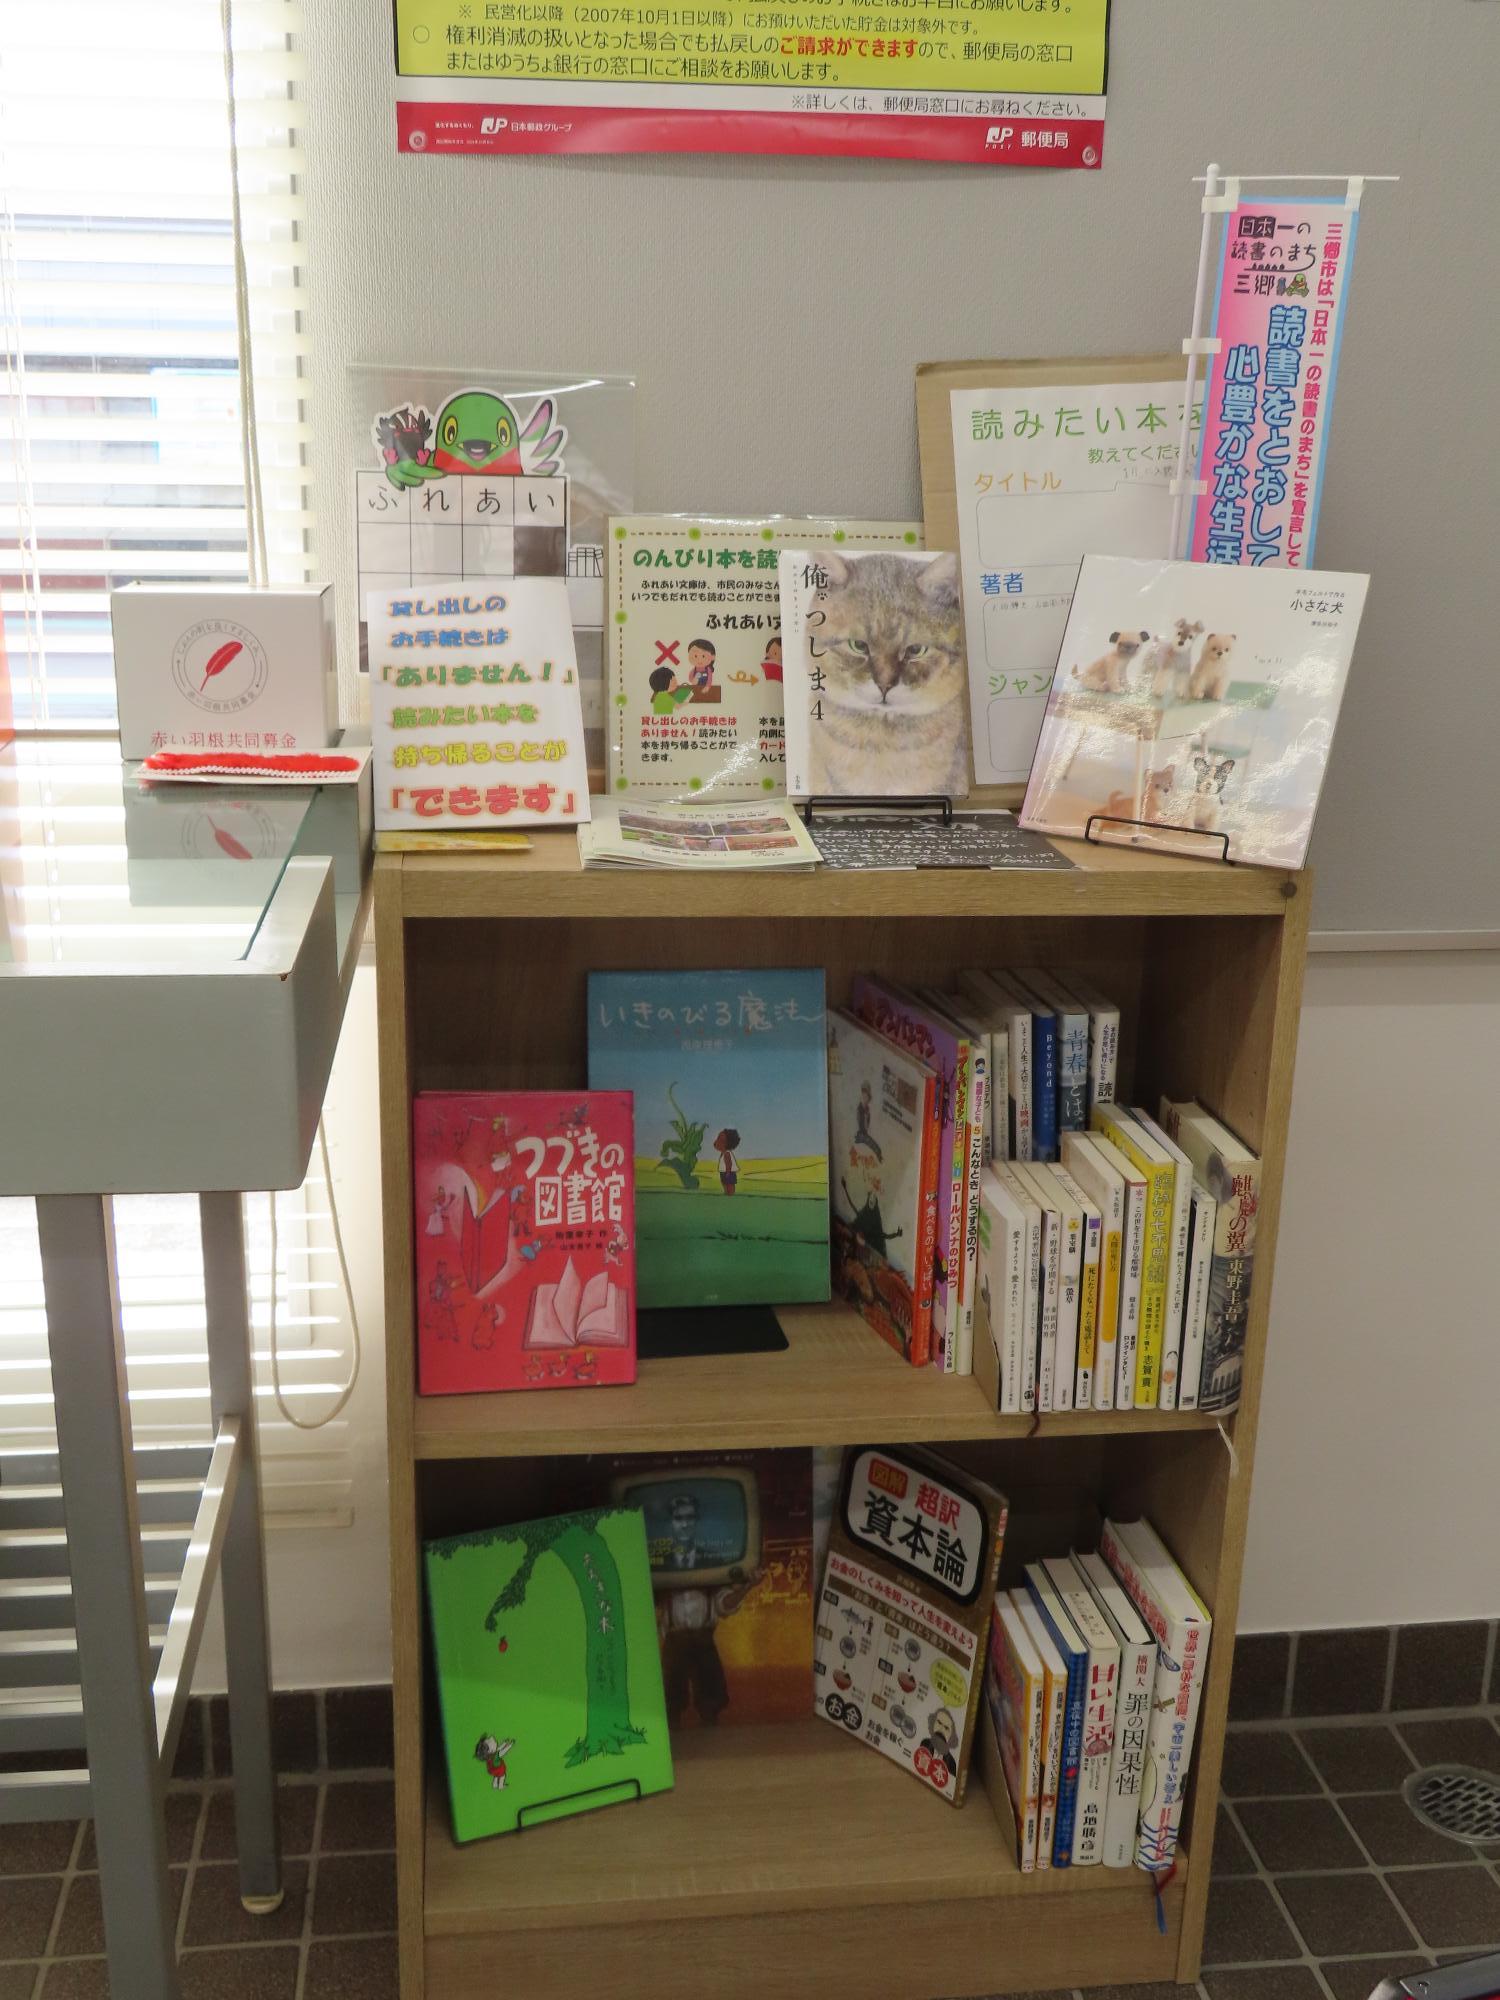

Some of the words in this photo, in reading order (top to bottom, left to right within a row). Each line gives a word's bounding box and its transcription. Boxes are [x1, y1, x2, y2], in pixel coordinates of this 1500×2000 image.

[446, 25, 1073, 63] 権利消滅の扱いとなった場合でも払戻しのご請求ができますので、郵便局の窓口
[446, 52, 840, 81] またはゆうちょ銀行の窓口にご相談をお願いします。
[792, 94, 1088, 118] ※詳しくは、郵便局窓口にお尋ねください。
[511, 121, 572, 132] 日本郵政グループ
[1021, 131, 1069, 149] 郵便局
[1237, 215, 1312, 239] 日本一の
[1231, 241, 1317, 272] 読書のまち
[1233, 274, 1275, 296] 三郷
[975, 472, 1061, 494] タイトル
[368, 485, 555, 515] ふれあい
[633, 548, 781, 569] のんびり本を読
[980, 572, 1024, 596] 著者
[390, 595, 506, 617] 貸し出しの
[1290, 599, 1344, 615] 小さな犬
[390, 628, 509, 648] お手続きは
[383, 663, 574, 687] 「ありません！」
[391, 703, 538, 728] 読みたい本を
[641, 716, 737, 725] 貸し出しのお手続きは
[809, 700, 825, 721] 4
[151, 731, 297, 749] 赤い羽根共同募金
[641, 741, 737, 750] 本を持ち帰ることがで
[394, 741, 567, 768] 持ち帰ることが
[391, 783, 575, 817] 「できます」
[600, 989, 826, 1031] いきのびる魔法
[1098, 1081, 1113, 1104] 読
[515, 1126, 625, 1179] つづきの
[969, 1138, 982, 1190] こんなとき
[534, 1170, 626, 1227] 図書館
[948, 1182, 961, 1289] ロールパンナのひみつ
[1223, 1259, 1244, 1321] 東野圭吾
[915, 1480, 961, 1530] 超訳
[859, 1490, 968, 1588] 資本論
[1115, 1692, 1150, 1796] 罪の因果性
